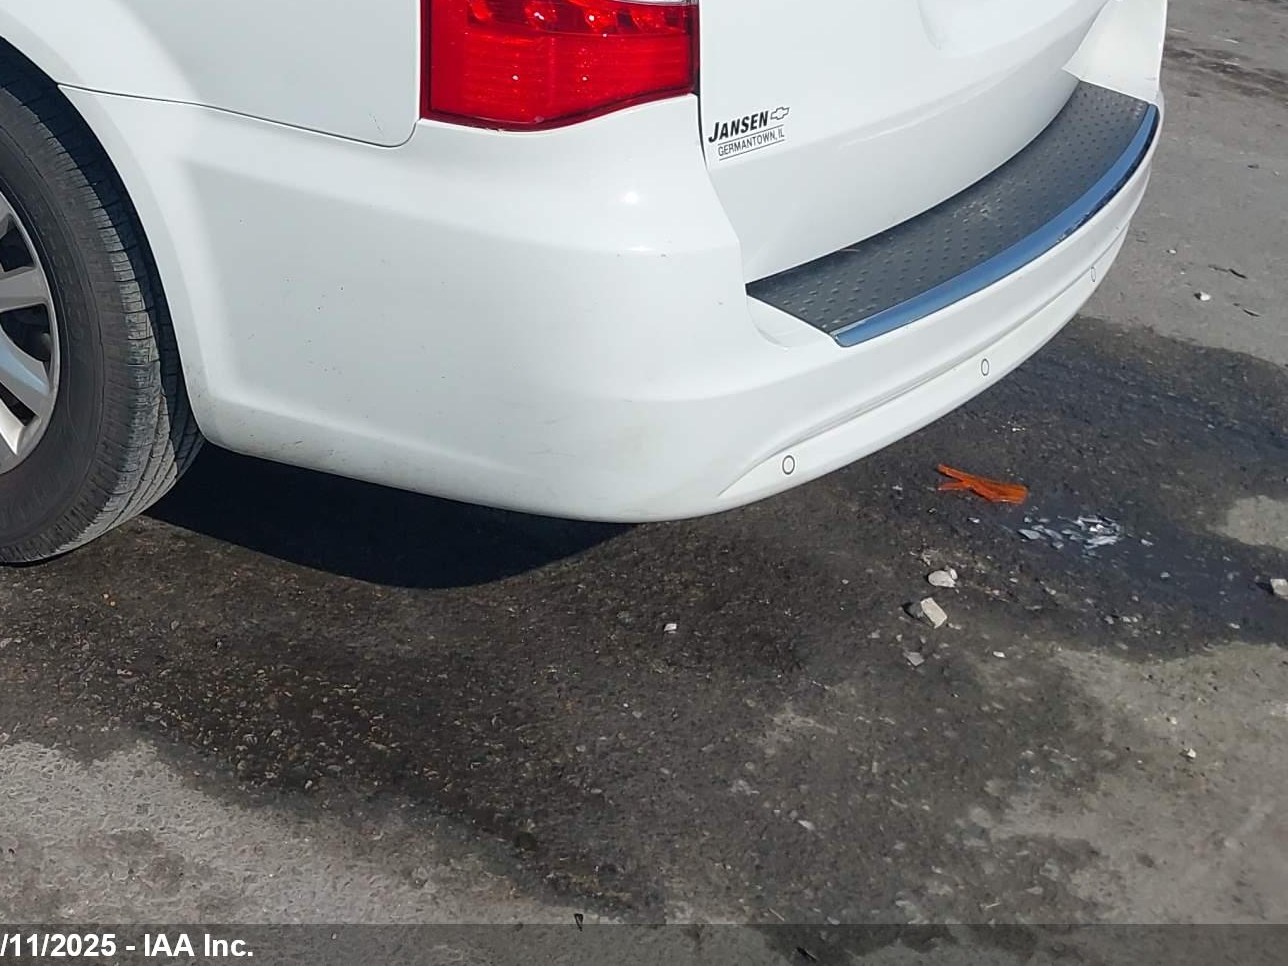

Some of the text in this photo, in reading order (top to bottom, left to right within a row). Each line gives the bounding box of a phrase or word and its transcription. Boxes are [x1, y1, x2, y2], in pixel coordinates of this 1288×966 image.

[708, 110, 769, 144] JANSEN
[717, 127, 785, 157] GERMANTOWN, IL
